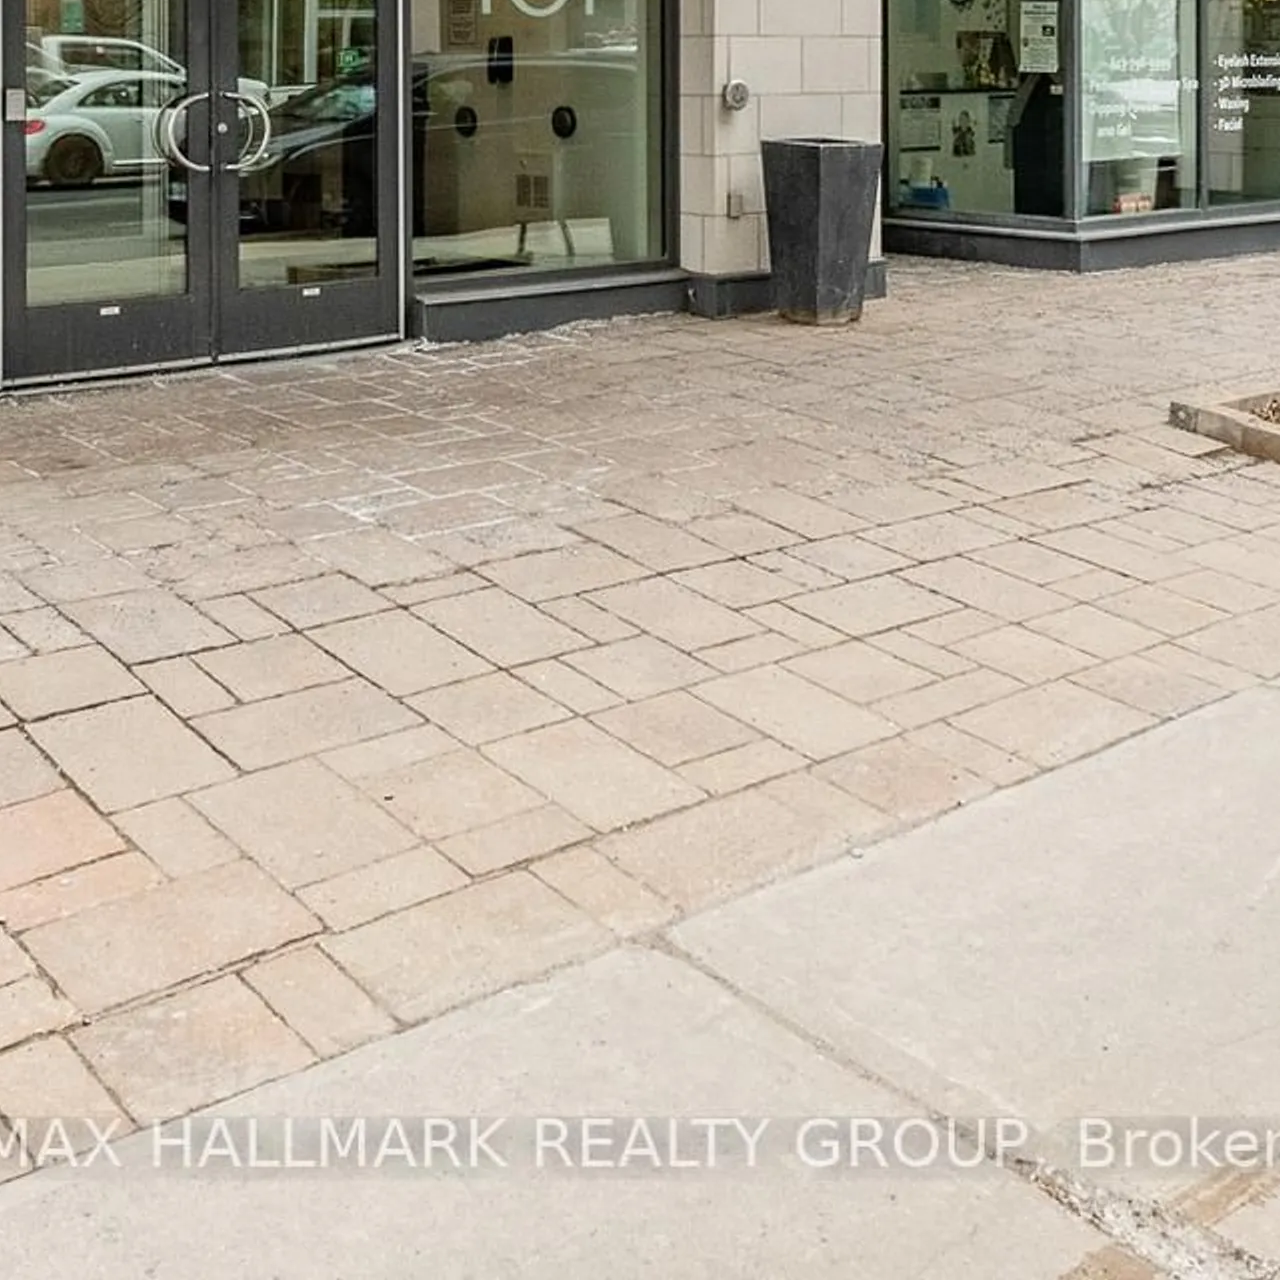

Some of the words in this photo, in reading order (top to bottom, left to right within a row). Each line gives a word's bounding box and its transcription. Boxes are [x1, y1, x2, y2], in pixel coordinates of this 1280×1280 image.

[1218, 54, 1249, 70] Eyelash
[1218, 97, 1249, 113] Waxing
[1218, 117, 1243, 131] Facial
